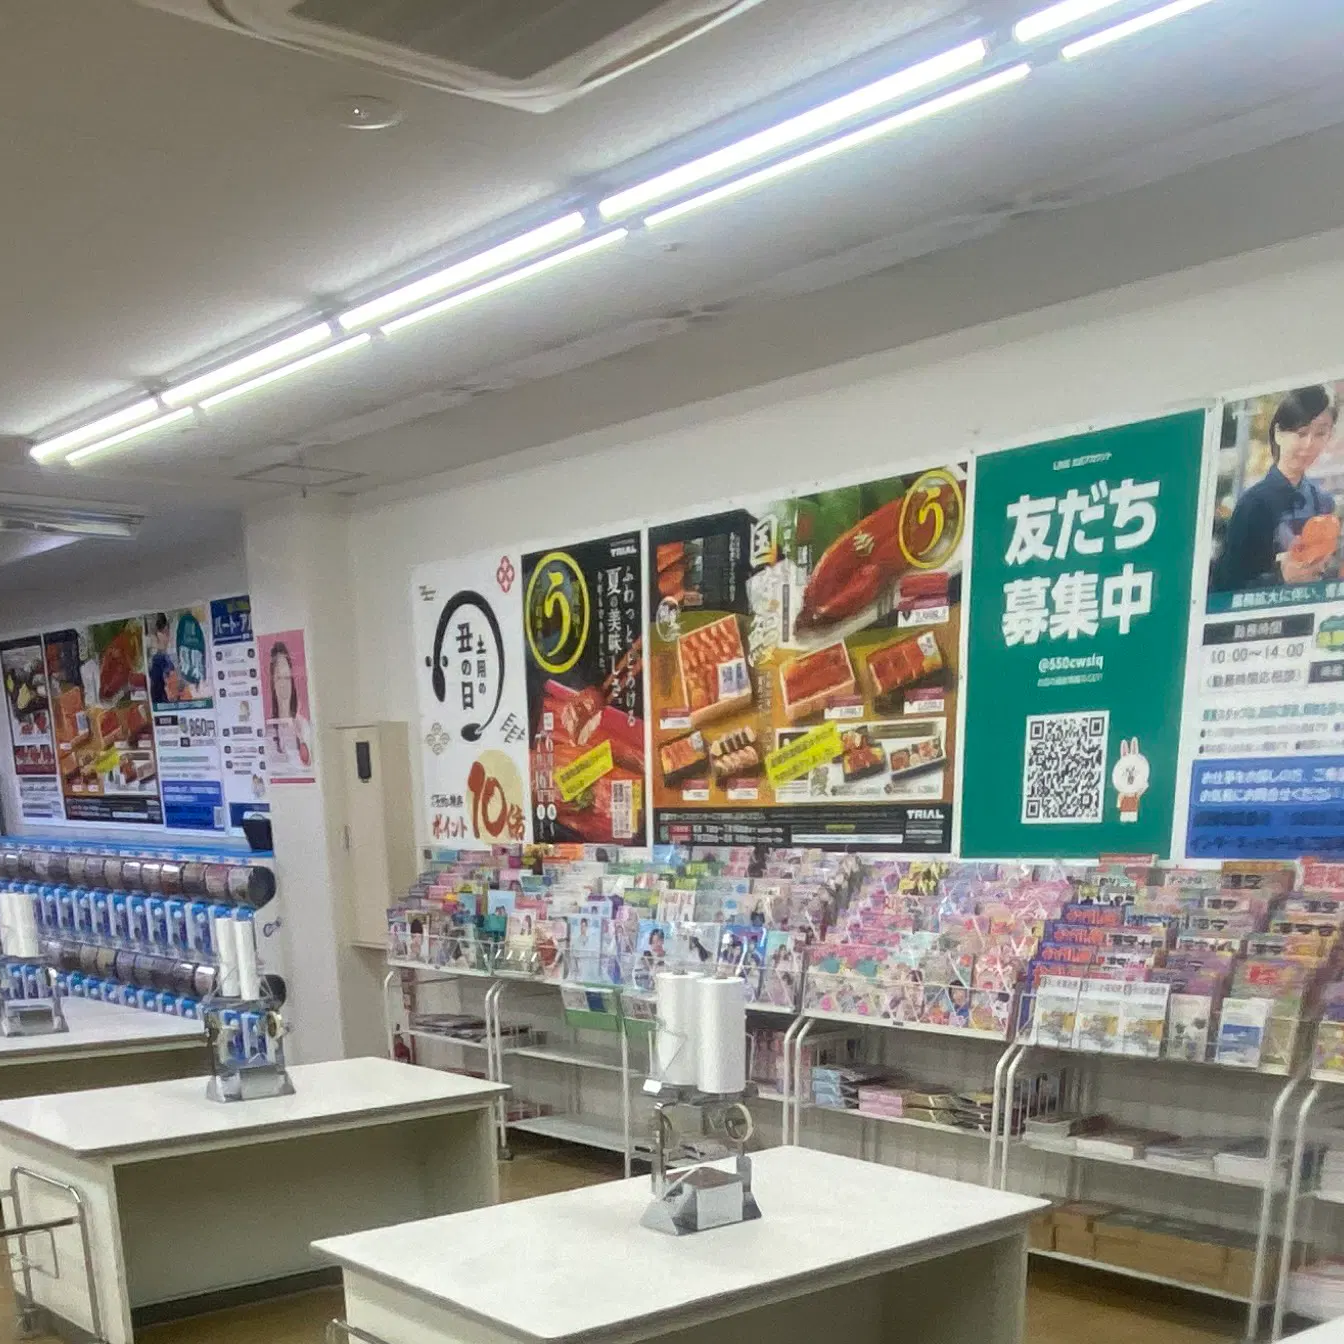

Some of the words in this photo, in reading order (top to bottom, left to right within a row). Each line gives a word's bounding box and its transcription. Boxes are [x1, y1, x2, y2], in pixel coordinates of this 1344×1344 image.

[1004, 478, 1160, 566] 友だち
[1002, 563, 1153, 647] 募集中
[455, 622, 474, 710] 丑の日
[432, 815, 467, 840] ポイント
[906, 808, 945, 820] TRIAL
